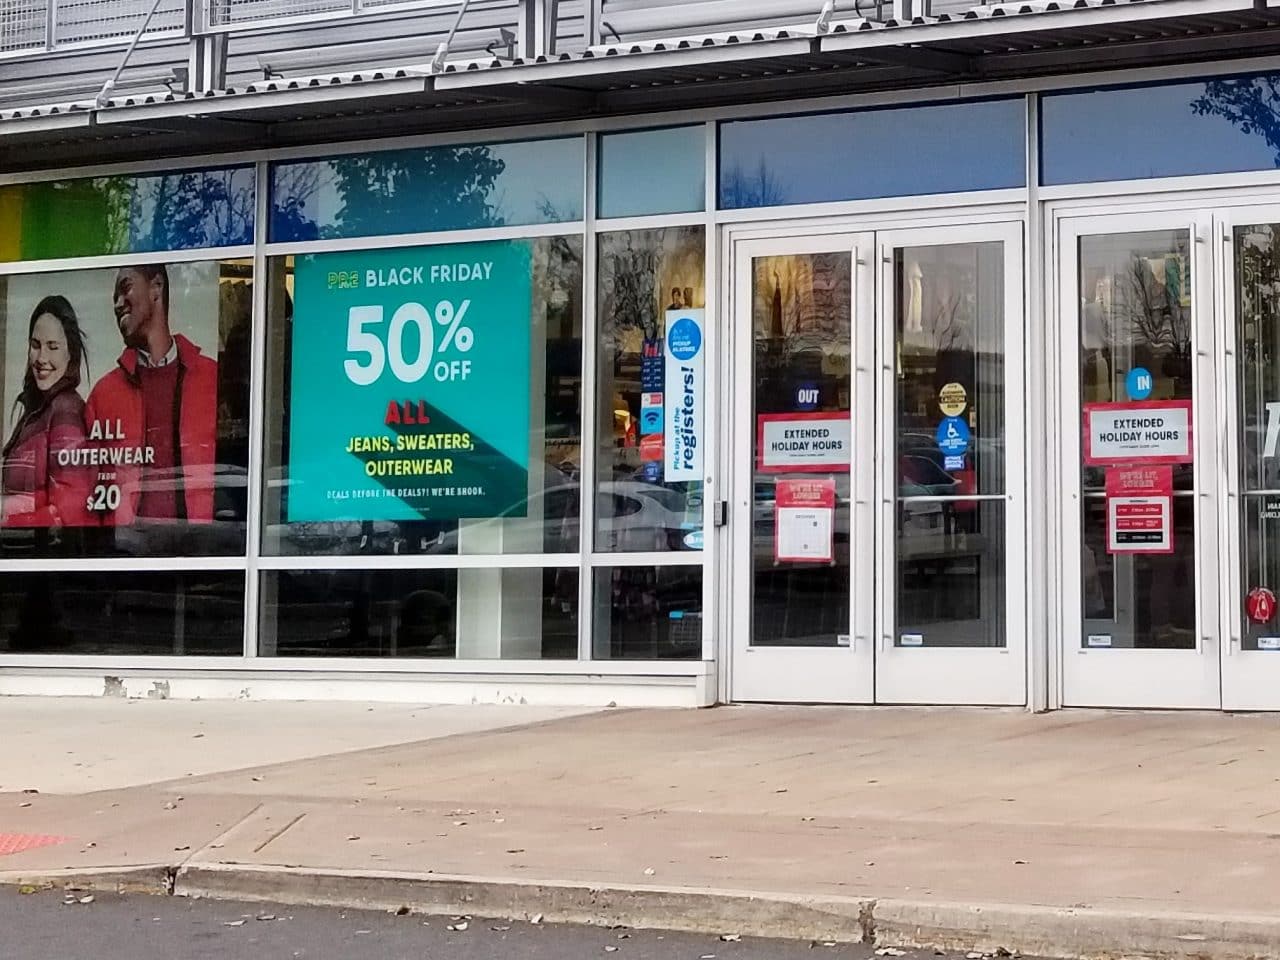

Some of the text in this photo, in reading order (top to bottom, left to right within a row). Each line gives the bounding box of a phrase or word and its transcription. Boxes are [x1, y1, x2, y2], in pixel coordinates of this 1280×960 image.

[327, 261, 494, 289] PRE BLACK FRIDAY
[343, 298, 475, 386] 50%
[433, 359, 472, 382] OFF
[1137, 375, 1150, 391] IN
[798, 389, 820, 404] OUT
[385, 399, 430, 425] ALL
[681, 366, 697, 470] registers!
[89, 418, 125, 440] ALL
[784, 428, 830, 439] EXTENDED
[1113, 418, 1164, 429] EXTENDED
[346, 433, 474, 453] JEANS, SWEATERS,
[771, 440, 842, 452] HOLIDAY HOURS
[1099, 430, 1179, 443] HOLIDAY HOURS
[58, 446, 155, 466] OUTERWEAR
[98, 472, 117, 481] FROM
[365, 458, 453, 476] OUTERWEAR
[86, 484, 121, 511] $20
